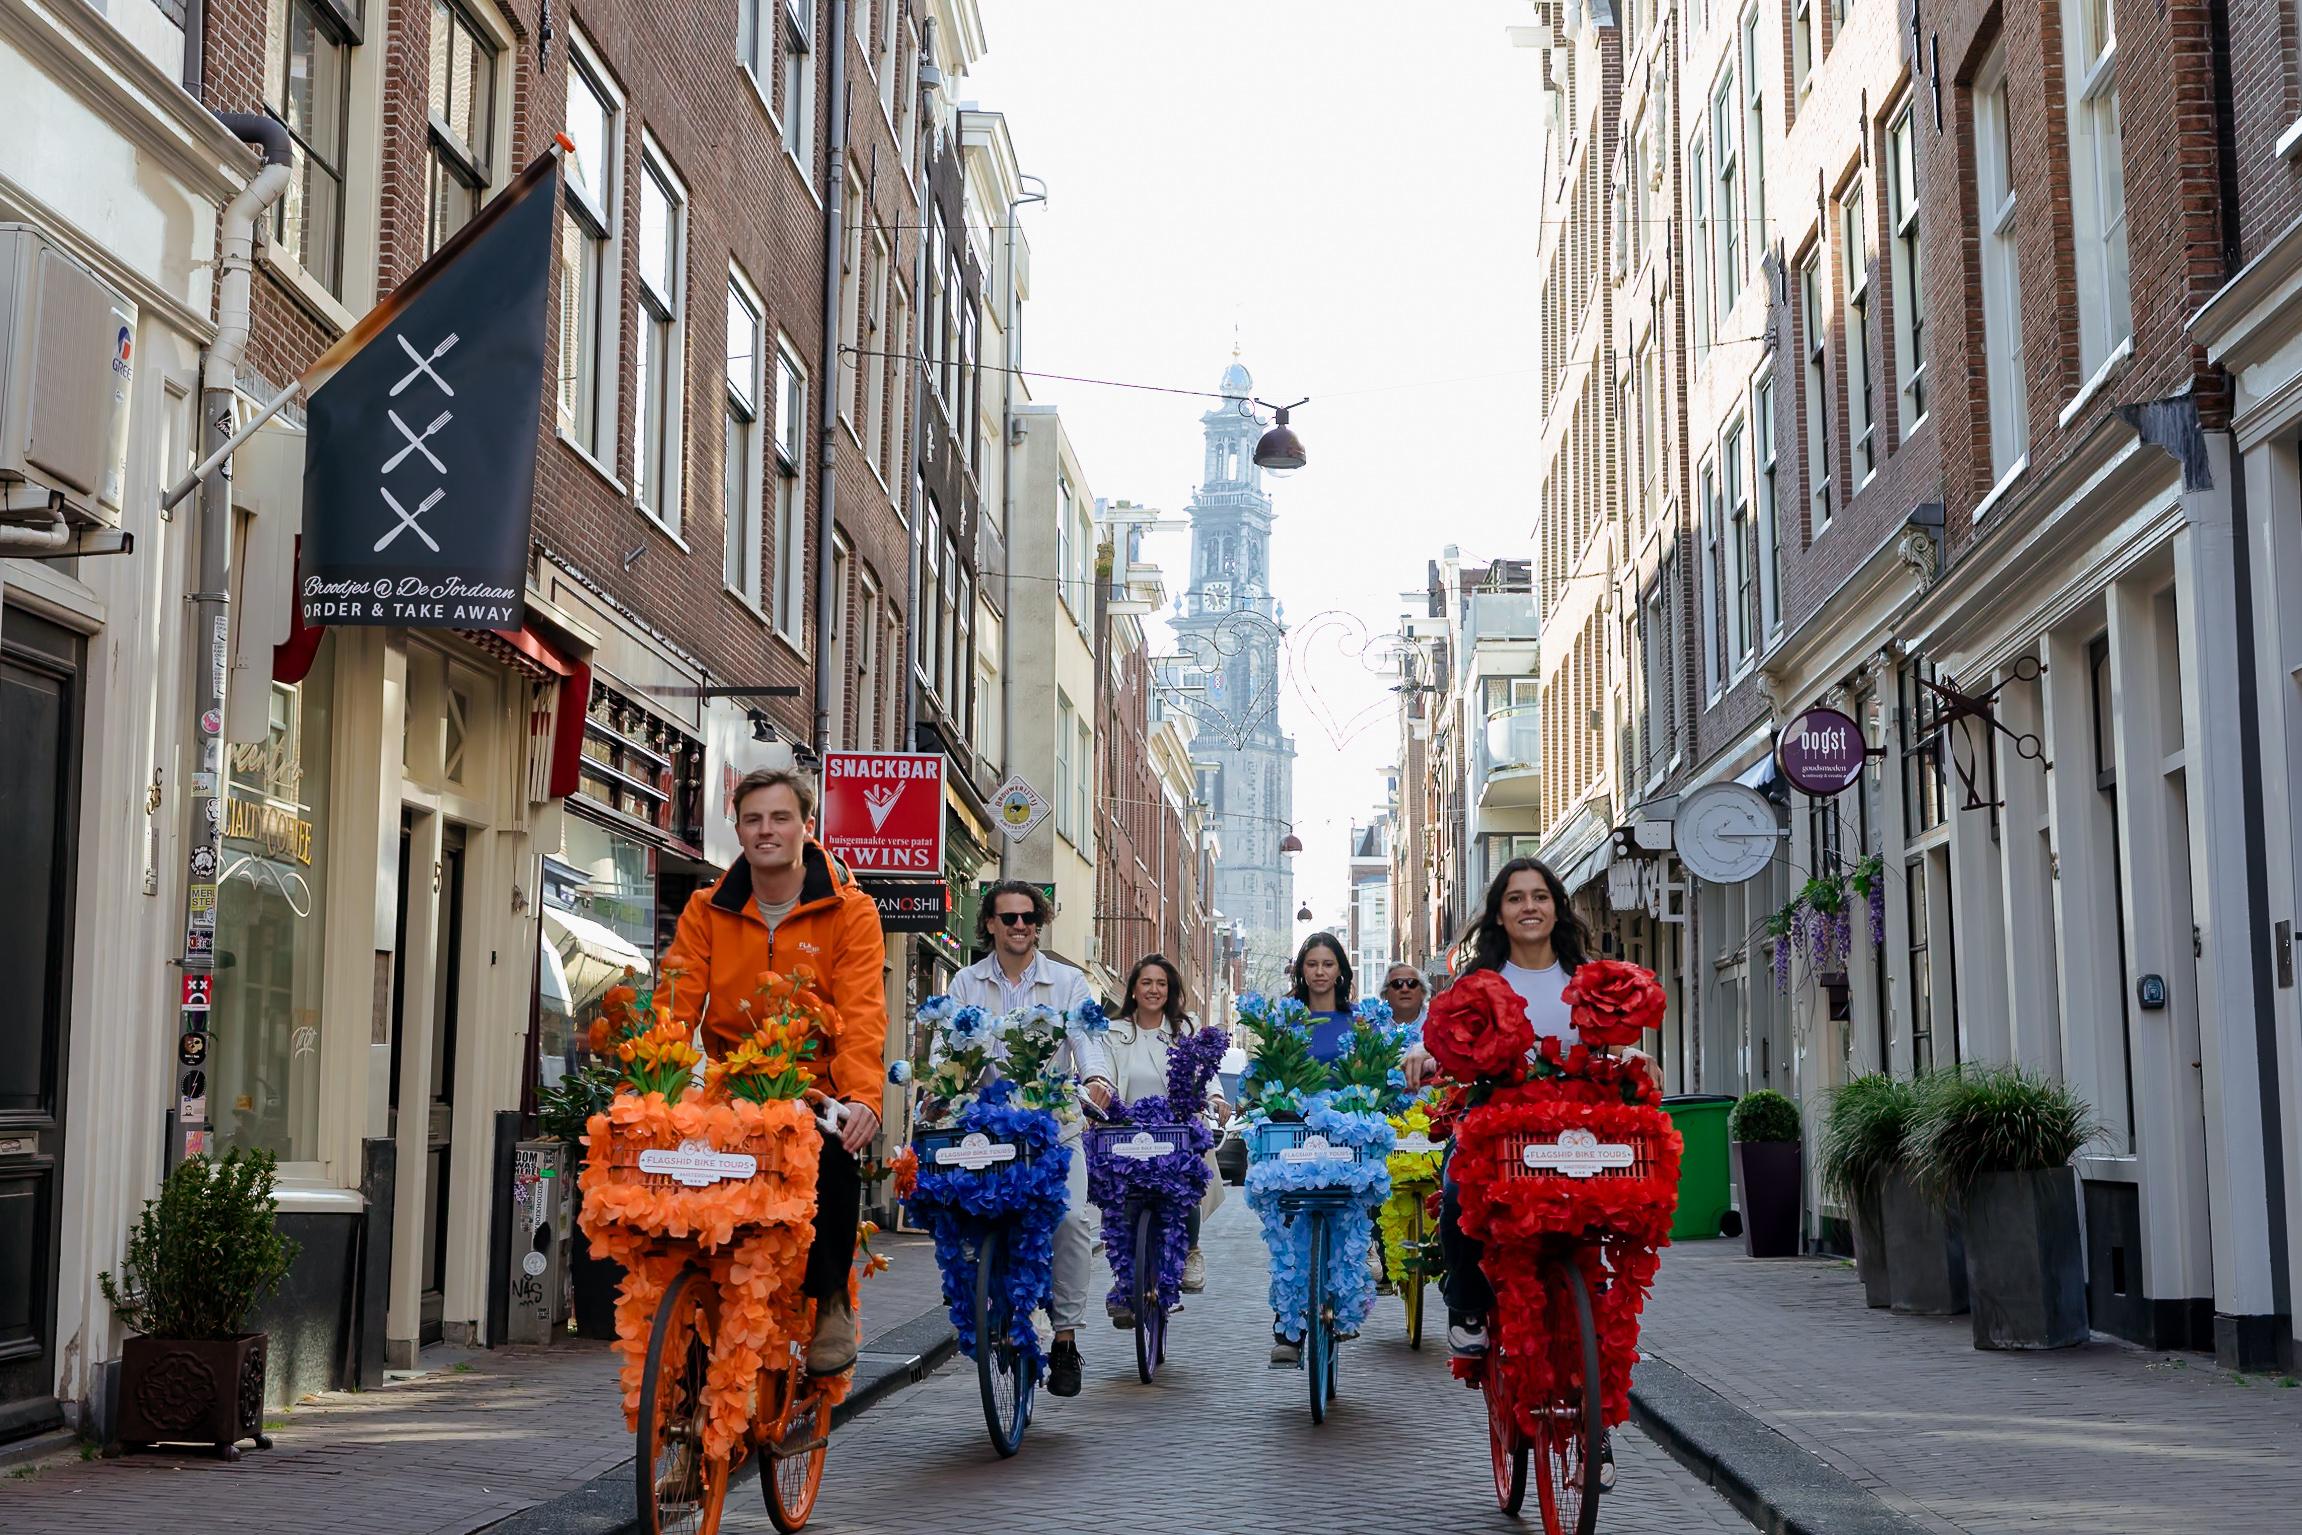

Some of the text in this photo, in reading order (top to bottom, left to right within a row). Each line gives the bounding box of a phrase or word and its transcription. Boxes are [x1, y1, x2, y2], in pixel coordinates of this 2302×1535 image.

[112, 357, 132, 381] GREE
[303, 575, 516, 600] Broodjes @ De Jordaan
[303, 602, 513, 621] ORDER & TAKE AWAY
[1801, 727, 1847, 755] oogst
[830, 758, 938, 779] SNACKBAR
[1801, 765, 1847, 773] goudsmeden
[995, 786, 1029, 807] BROUWERIJ
[1000, 819, 1034, 830] AMSTERDAM
[266, 808, 312, 866] COFFEE
[829, 835, 933, 848] huisgemaakte verse patat
[832, 847, 930, 867] TWINS
[873, 897, 940, 911] ANOSHII
[646, 1156, 750, 1169] FLAGSHIP BIKE TOURS
